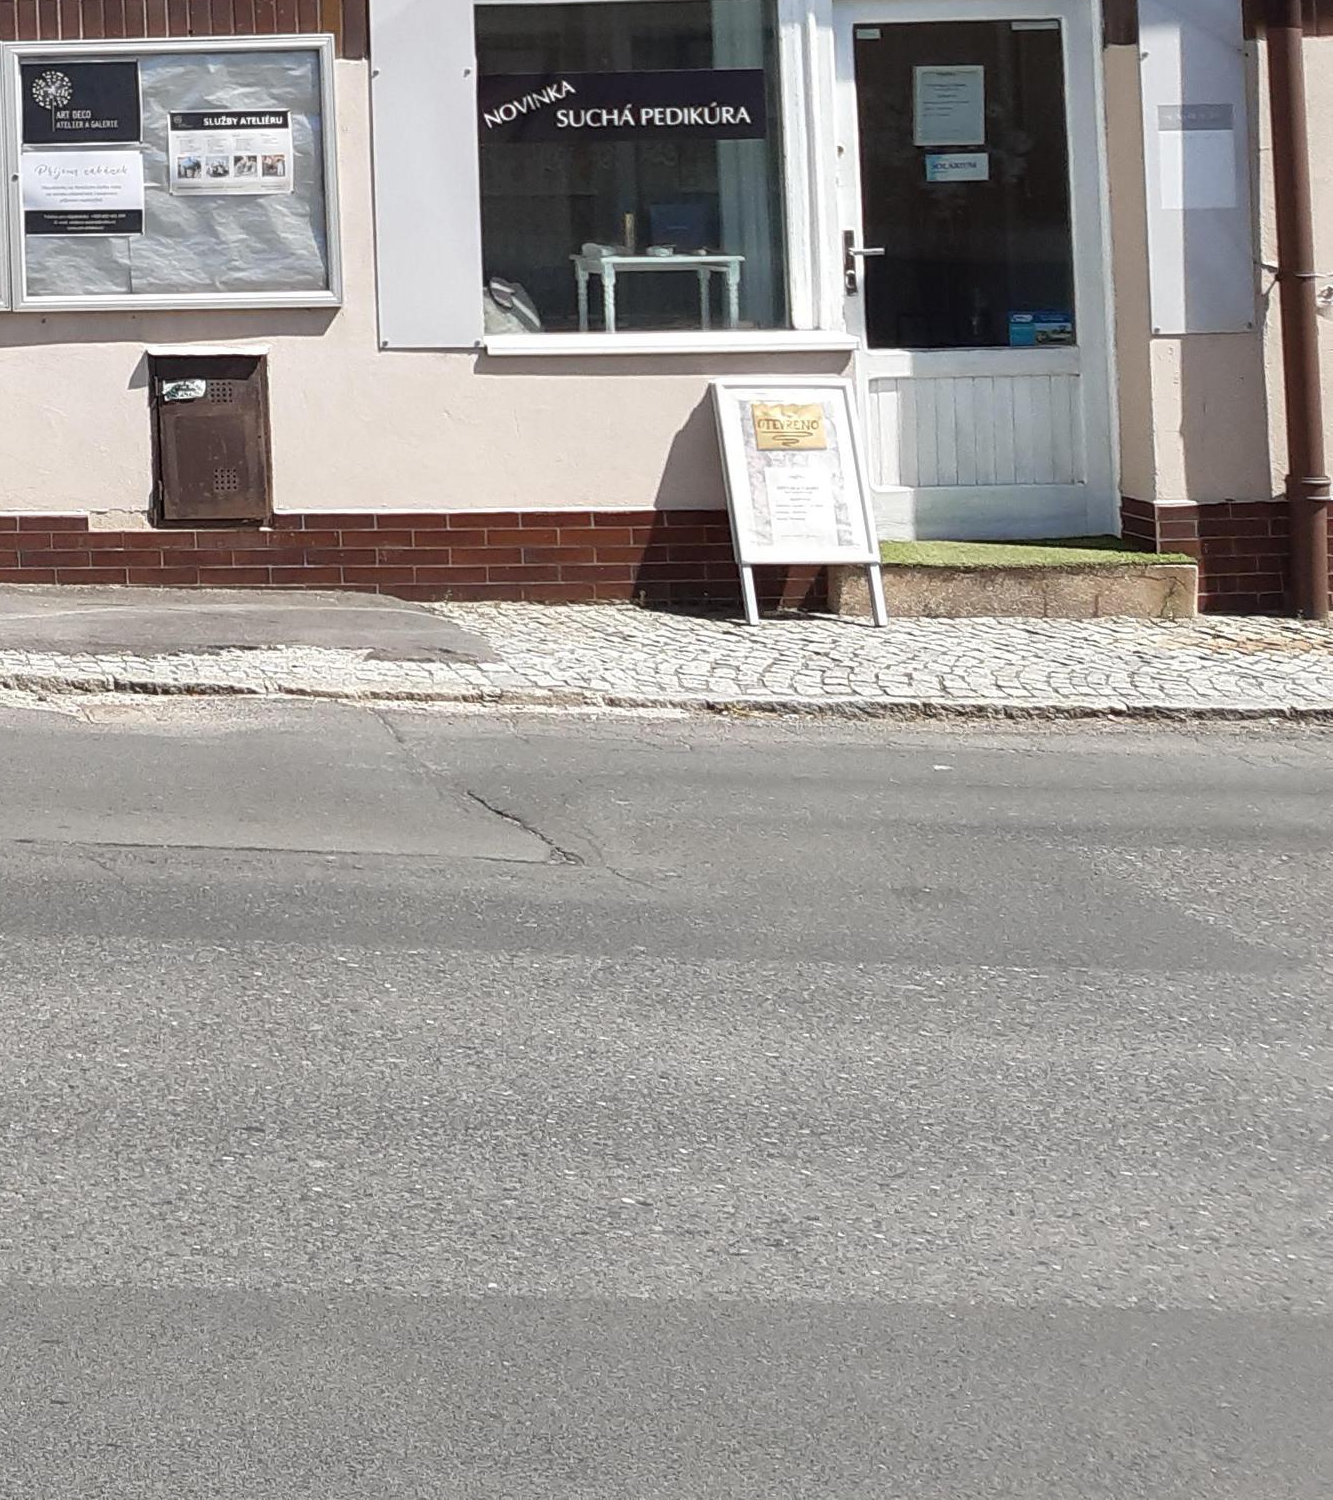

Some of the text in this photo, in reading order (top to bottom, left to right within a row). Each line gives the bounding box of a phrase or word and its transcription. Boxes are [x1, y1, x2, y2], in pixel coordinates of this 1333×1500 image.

[483, 79, 577, 130] NOVINKA
[56, 110, 92, 119] ART DECO
[203, 115, 283, 126] SLUŽBY ATELIÉRU
[556, 102, 752, 128] SUCHÁ PEDIKÚRA
